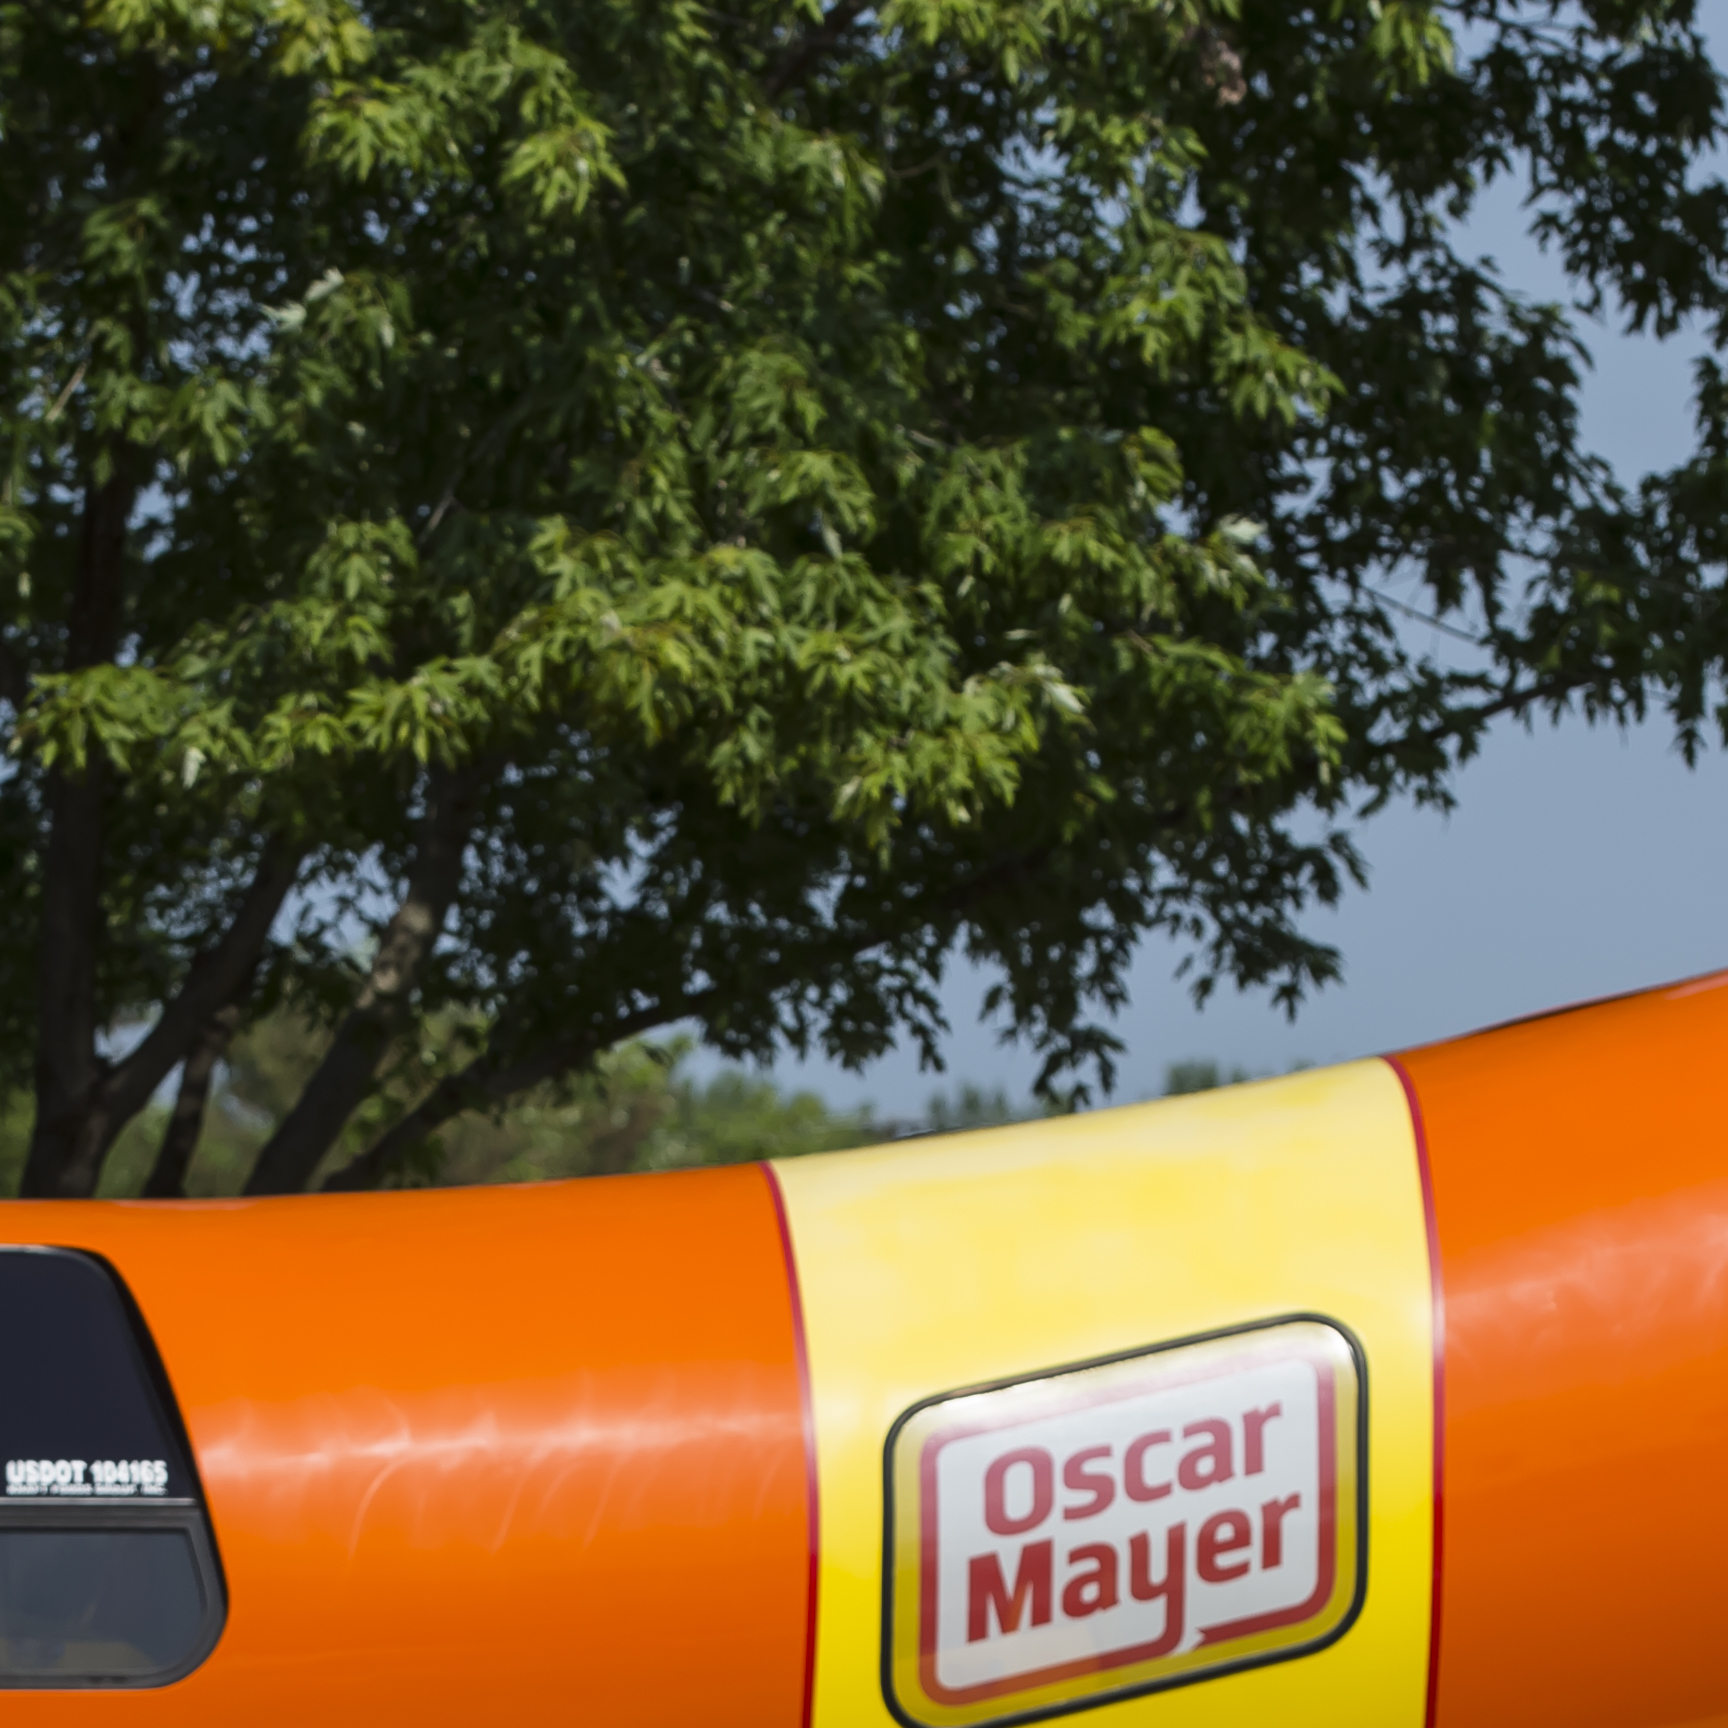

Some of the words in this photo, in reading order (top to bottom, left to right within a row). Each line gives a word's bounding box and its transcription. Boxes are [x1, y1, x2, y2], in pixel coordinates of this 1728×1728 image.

[5, 1459, 88, 1485] USDOT
[982, 1400, 1284, 1537] Oscar
[965, 1492, 1303, 1650] Mayer
